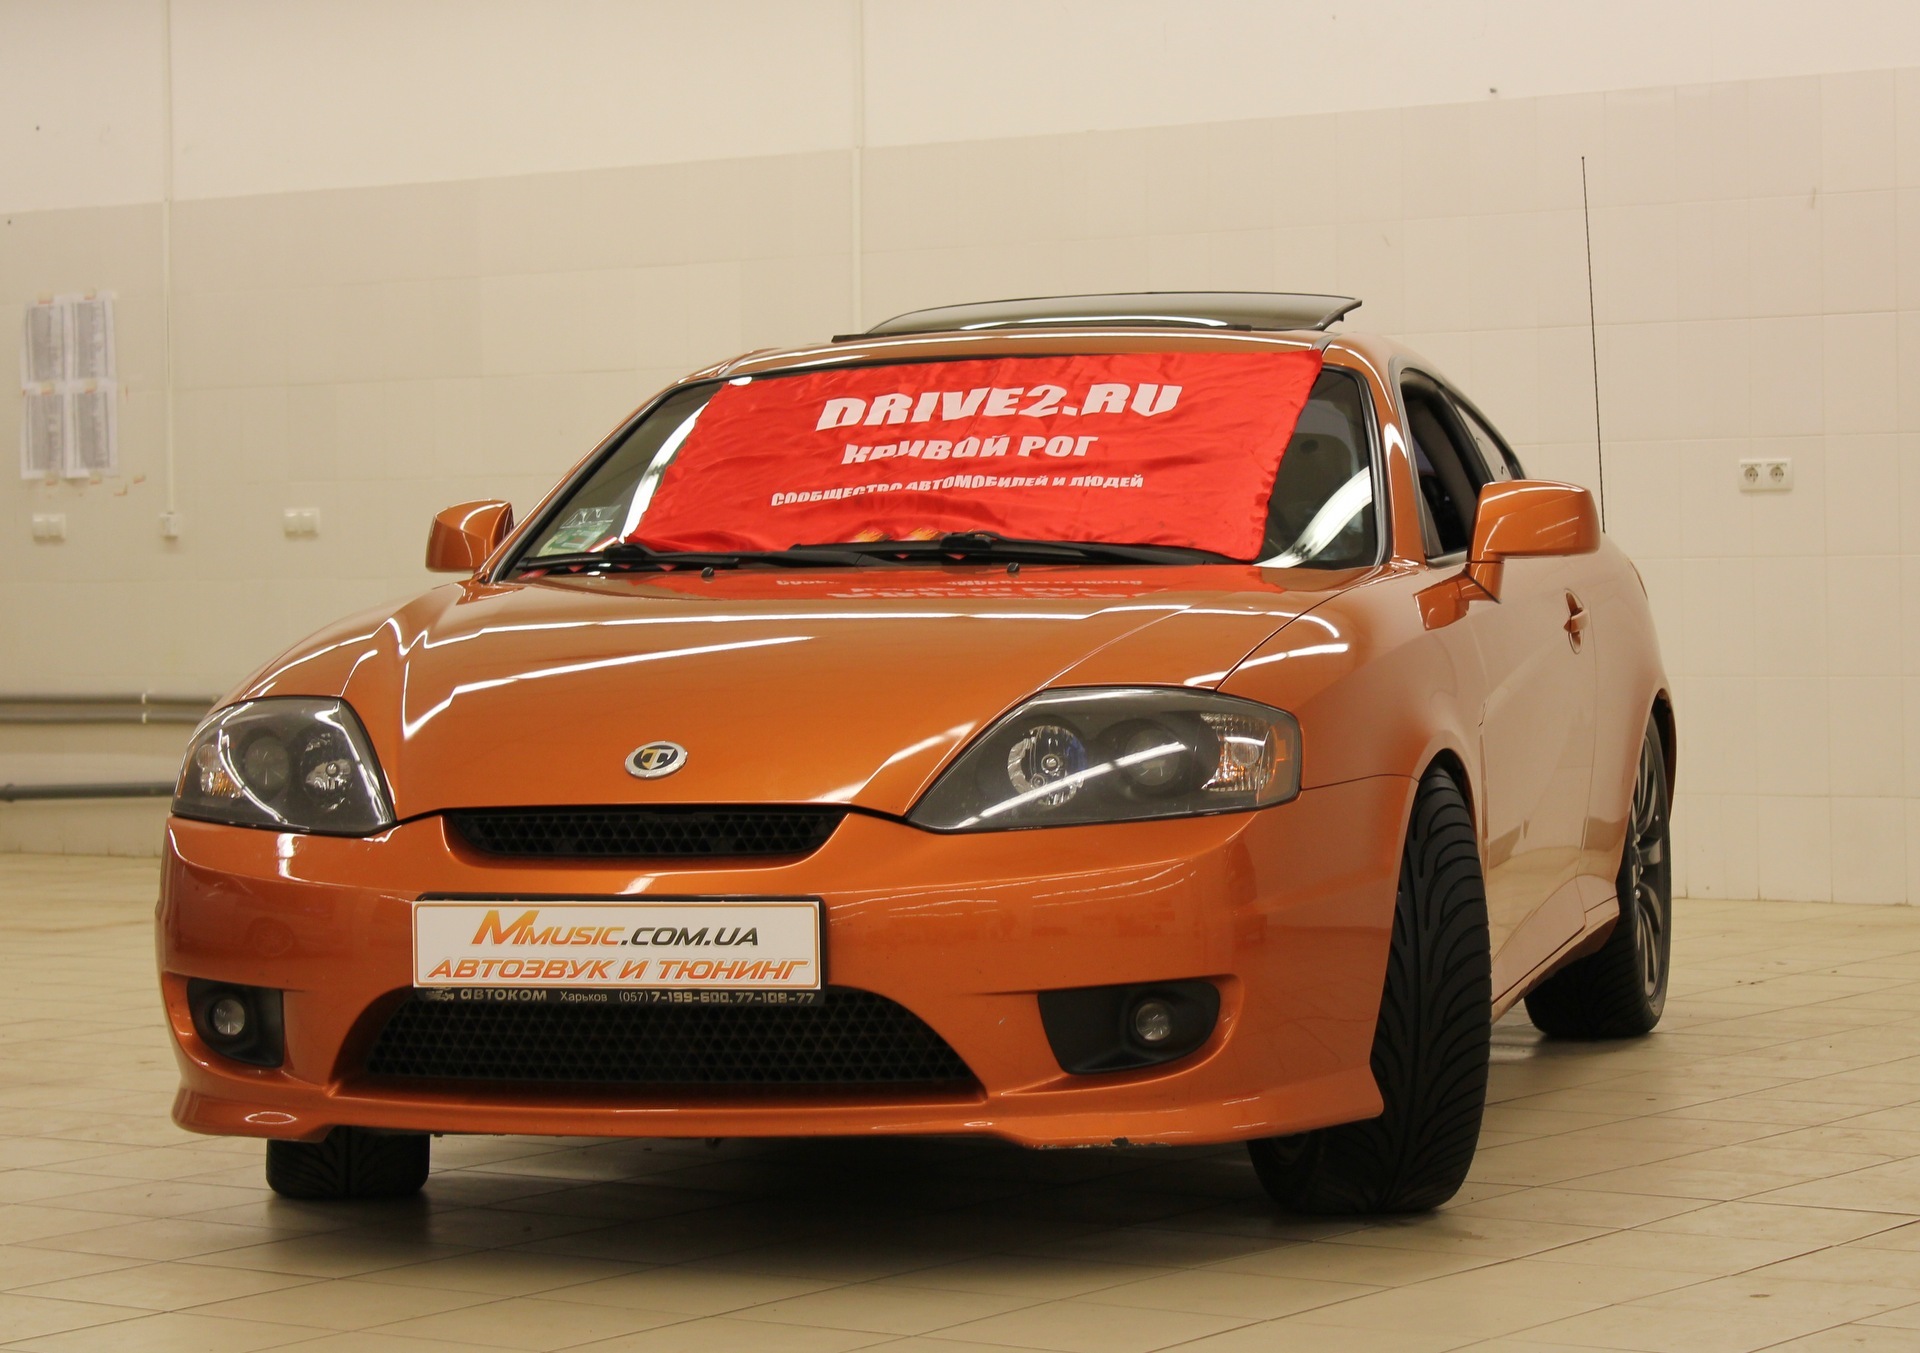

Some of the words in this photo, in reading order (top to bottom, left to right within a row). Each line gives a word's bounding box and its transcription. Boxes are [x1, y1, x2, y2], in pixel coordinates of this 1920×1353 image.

[815, 383, 1183, 431] DRIVE2.RU
[841, 434, 1010, 465] КРИВОЙ
[1017, 436, 1099, 457] РОГ
[905, 474, 1048, 492] АВТОМОБИЛЕЙ
[1069, 474, 1144, 487] ЛЮДЕЙ
[427, 959, 615, 980] АВТОЗВУК
[619, 960, 654, 980] И
[657, 960, 810, 980] ТЮНИНГ
[560, 991, 607, 1003] Харьков
[618, 991, 648, 1003] (057)
